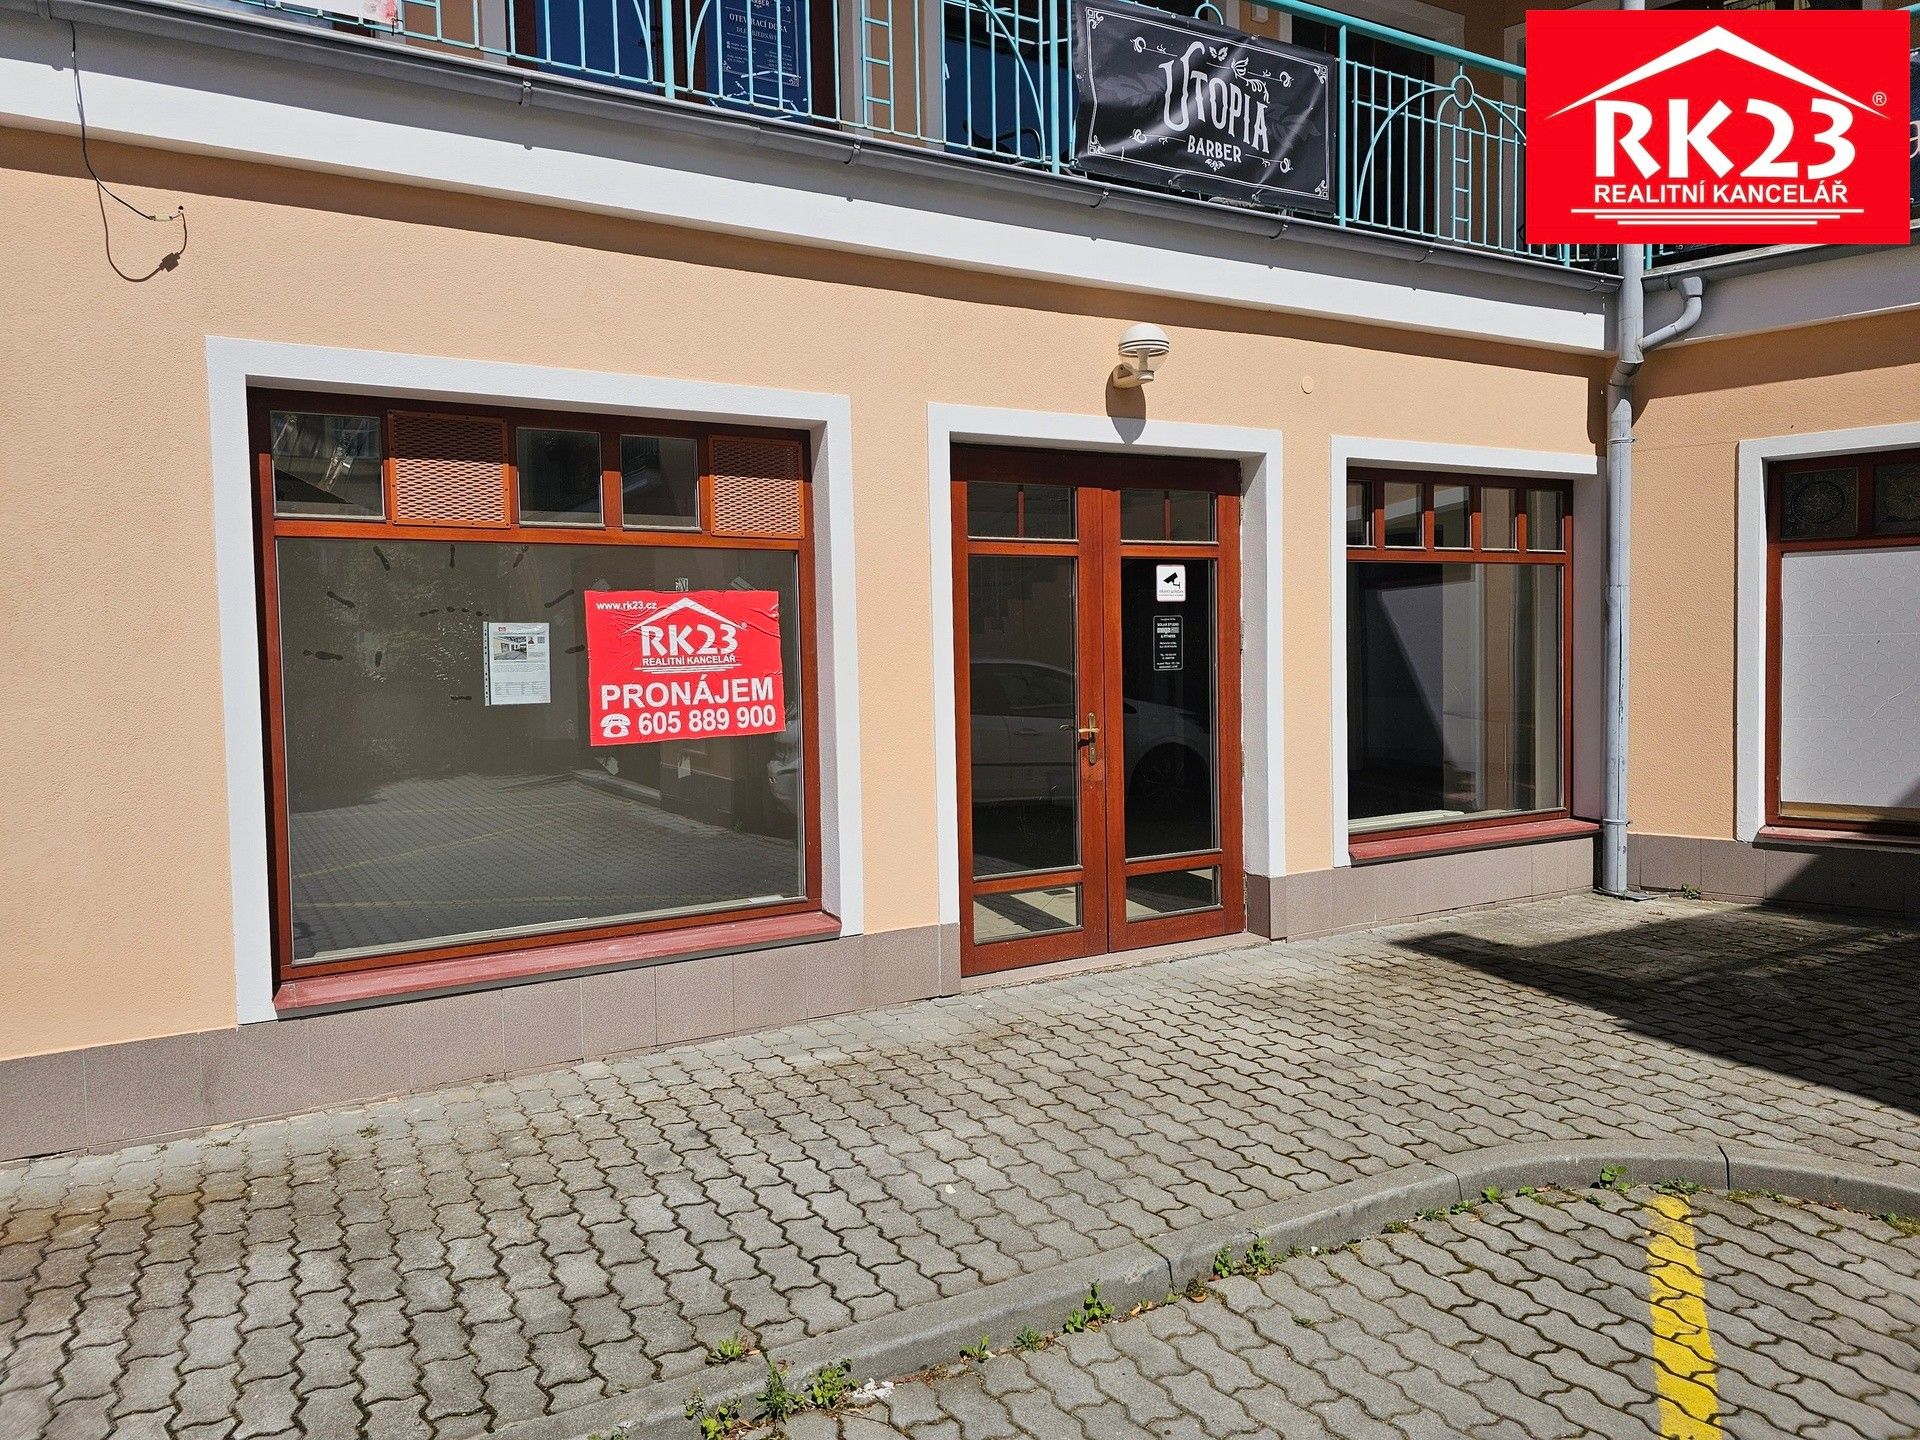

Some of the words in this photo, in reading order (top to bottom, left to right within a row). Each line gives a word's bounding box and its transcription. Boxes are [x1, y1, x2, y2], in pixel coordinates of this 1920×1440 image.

[1158, 41, 1269, 154] UTOPIA
[1187, 134, 1242, 163] BARBER
[596, 601, 657, 610] www.rk23.cz
[640, 624, 738, 656] RK23
[642, 655, 685, 666] REALITNÍ
[687, 653, 736, 665] KANCELÁŘ
[601, 674, 774, 710] PRONÁJEM
[638, 710, 681, 736] 605
[688, 707, 730, 733] 889
[736, 704, 776, 729] 900
